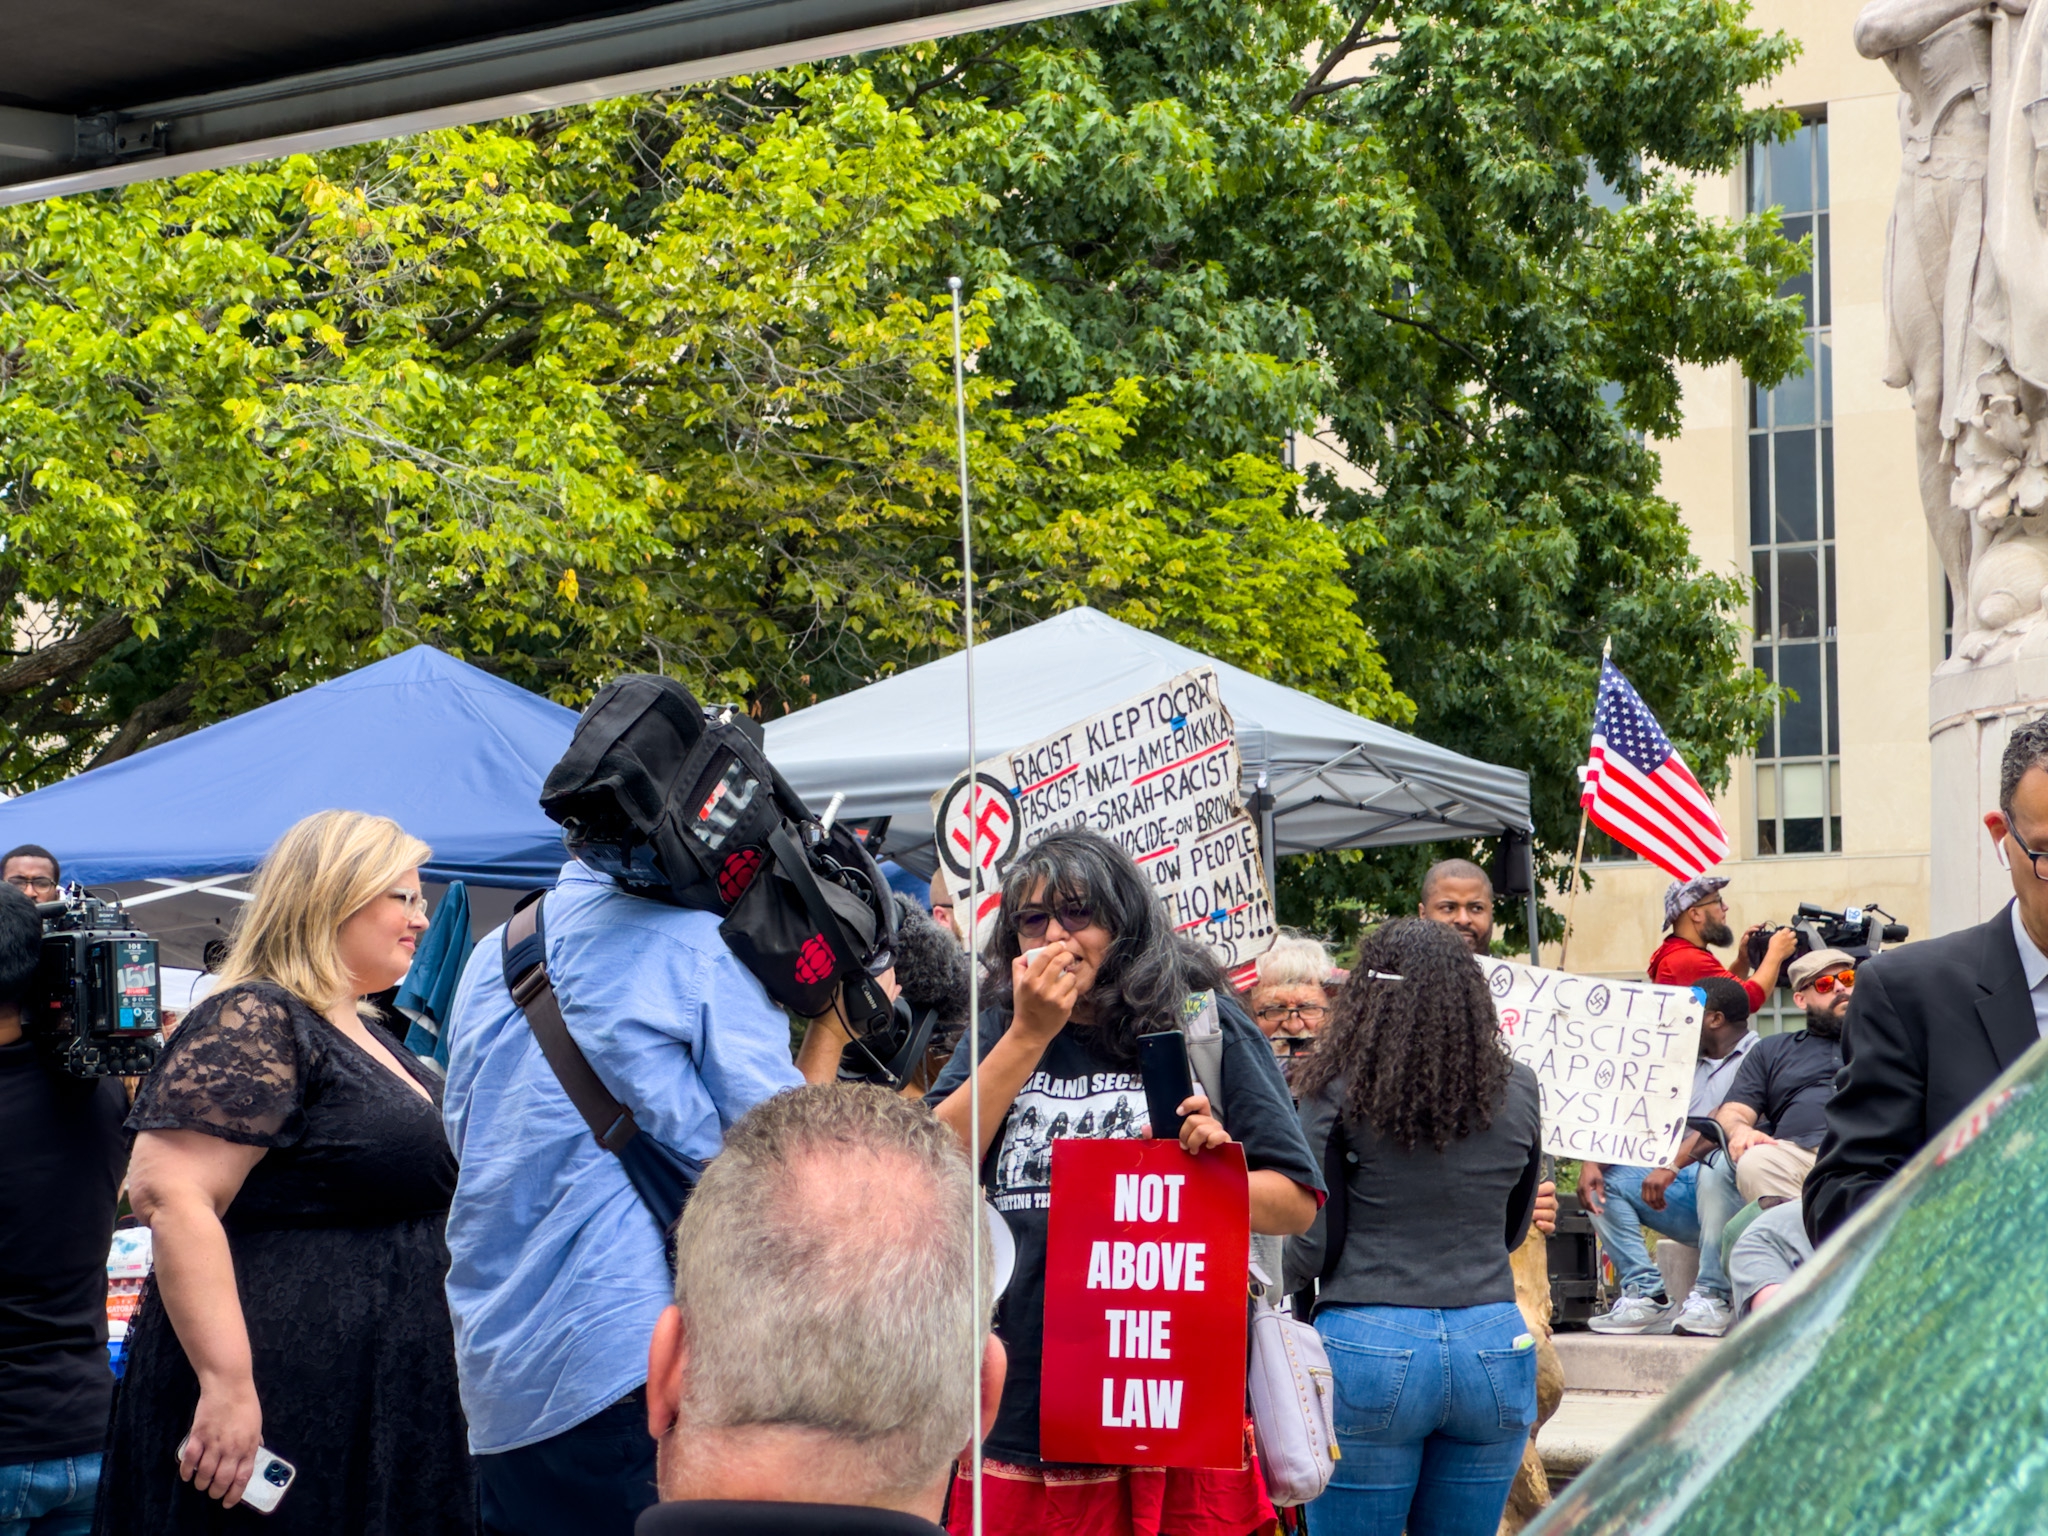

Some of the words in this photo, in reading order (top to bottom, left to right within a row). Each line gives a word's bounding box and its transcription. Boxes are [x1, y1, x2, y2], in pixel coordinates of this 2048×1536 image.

[1012, 734, 1073, 788] RACIST
[1086, 671, 1212, 757] KLEPTOCRAT
[1190, 825, 1255, 877] PEOPLE
[1487, 964, 1698, 1024] OYCOTT:
[1521, 1008, 1680, 1058] FASCIST
[1512, 1044, 1678, 1099] GAPORE,
[1538, 1083, 1671, 1134] AYSIA,
[1547, 1117, 1684, 1165] ACKING!
[1113, 1173, 1185, 1223] NOT
[1086, 1240, 1206, 1292] ABOVE
[1105, 1308, 1172, 1360] THE
[1101, 1377, 1184, 1430] LAW
